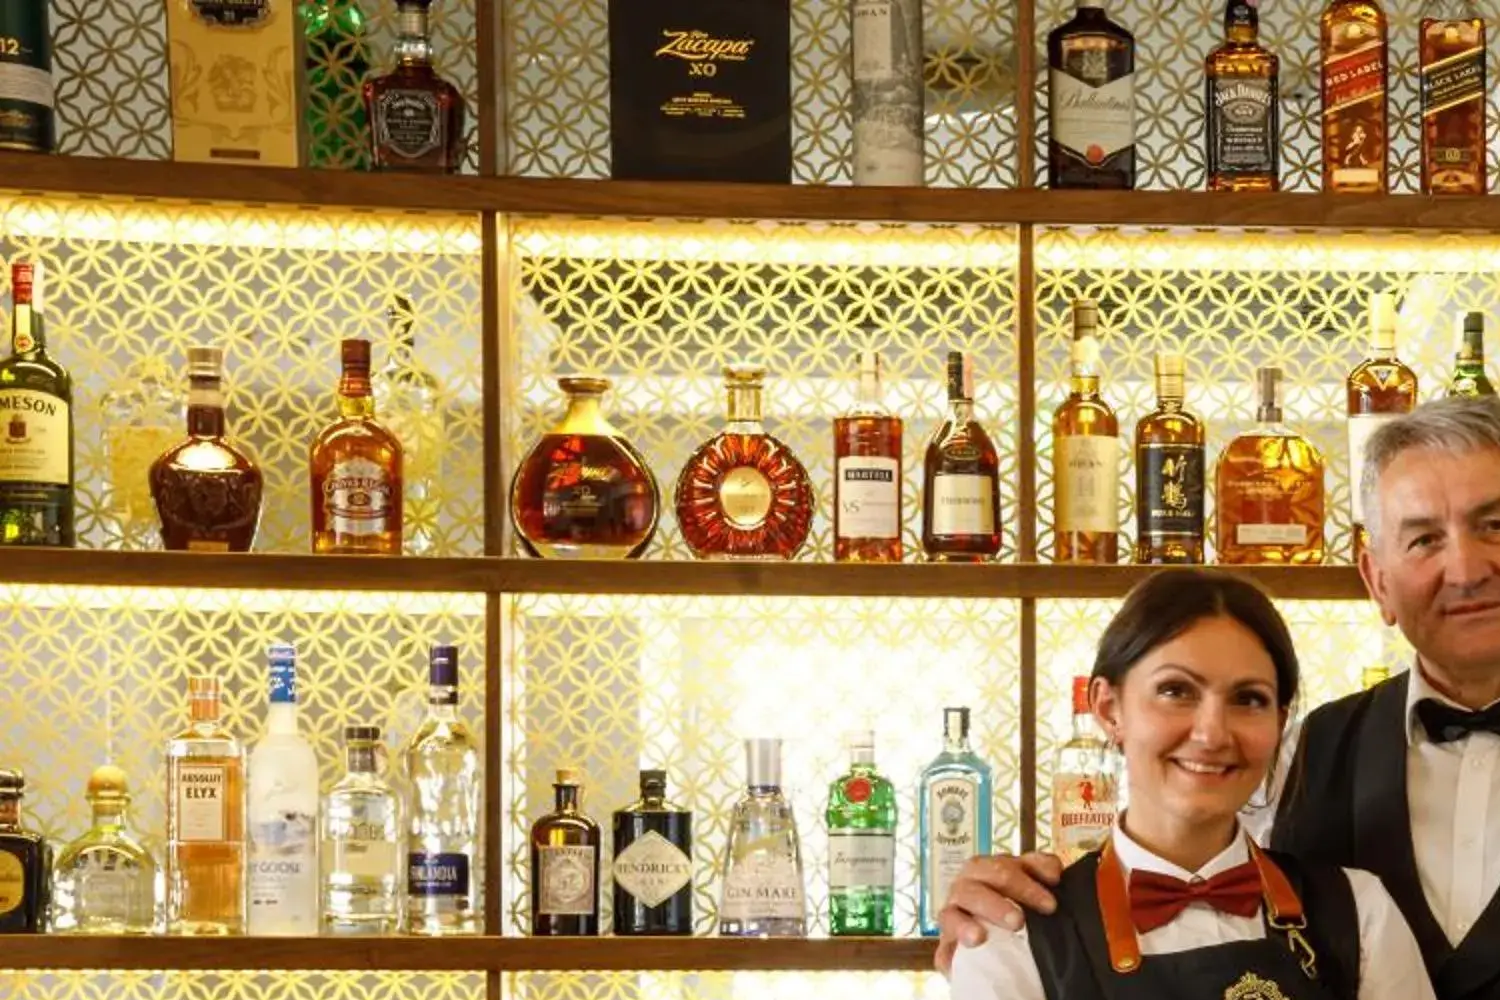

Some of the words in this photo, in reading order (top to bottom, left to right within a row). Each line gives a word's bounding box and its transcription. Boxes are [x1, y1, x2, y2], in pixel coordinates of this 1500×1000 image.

[689, 62, 717, 77] XO
[1325, 73, 1349, 87] RED
[1349, 61, 1383, 78] LABEL
[1423, 76, 1452, 92] BLACK
[1215, 86, 1237, 107] JACK
[182, 773, 221, 783] ABSOLUT
[186, 787, 217, 799] ELYX
[1061, 812, 1114, 827] BEEFEATER
